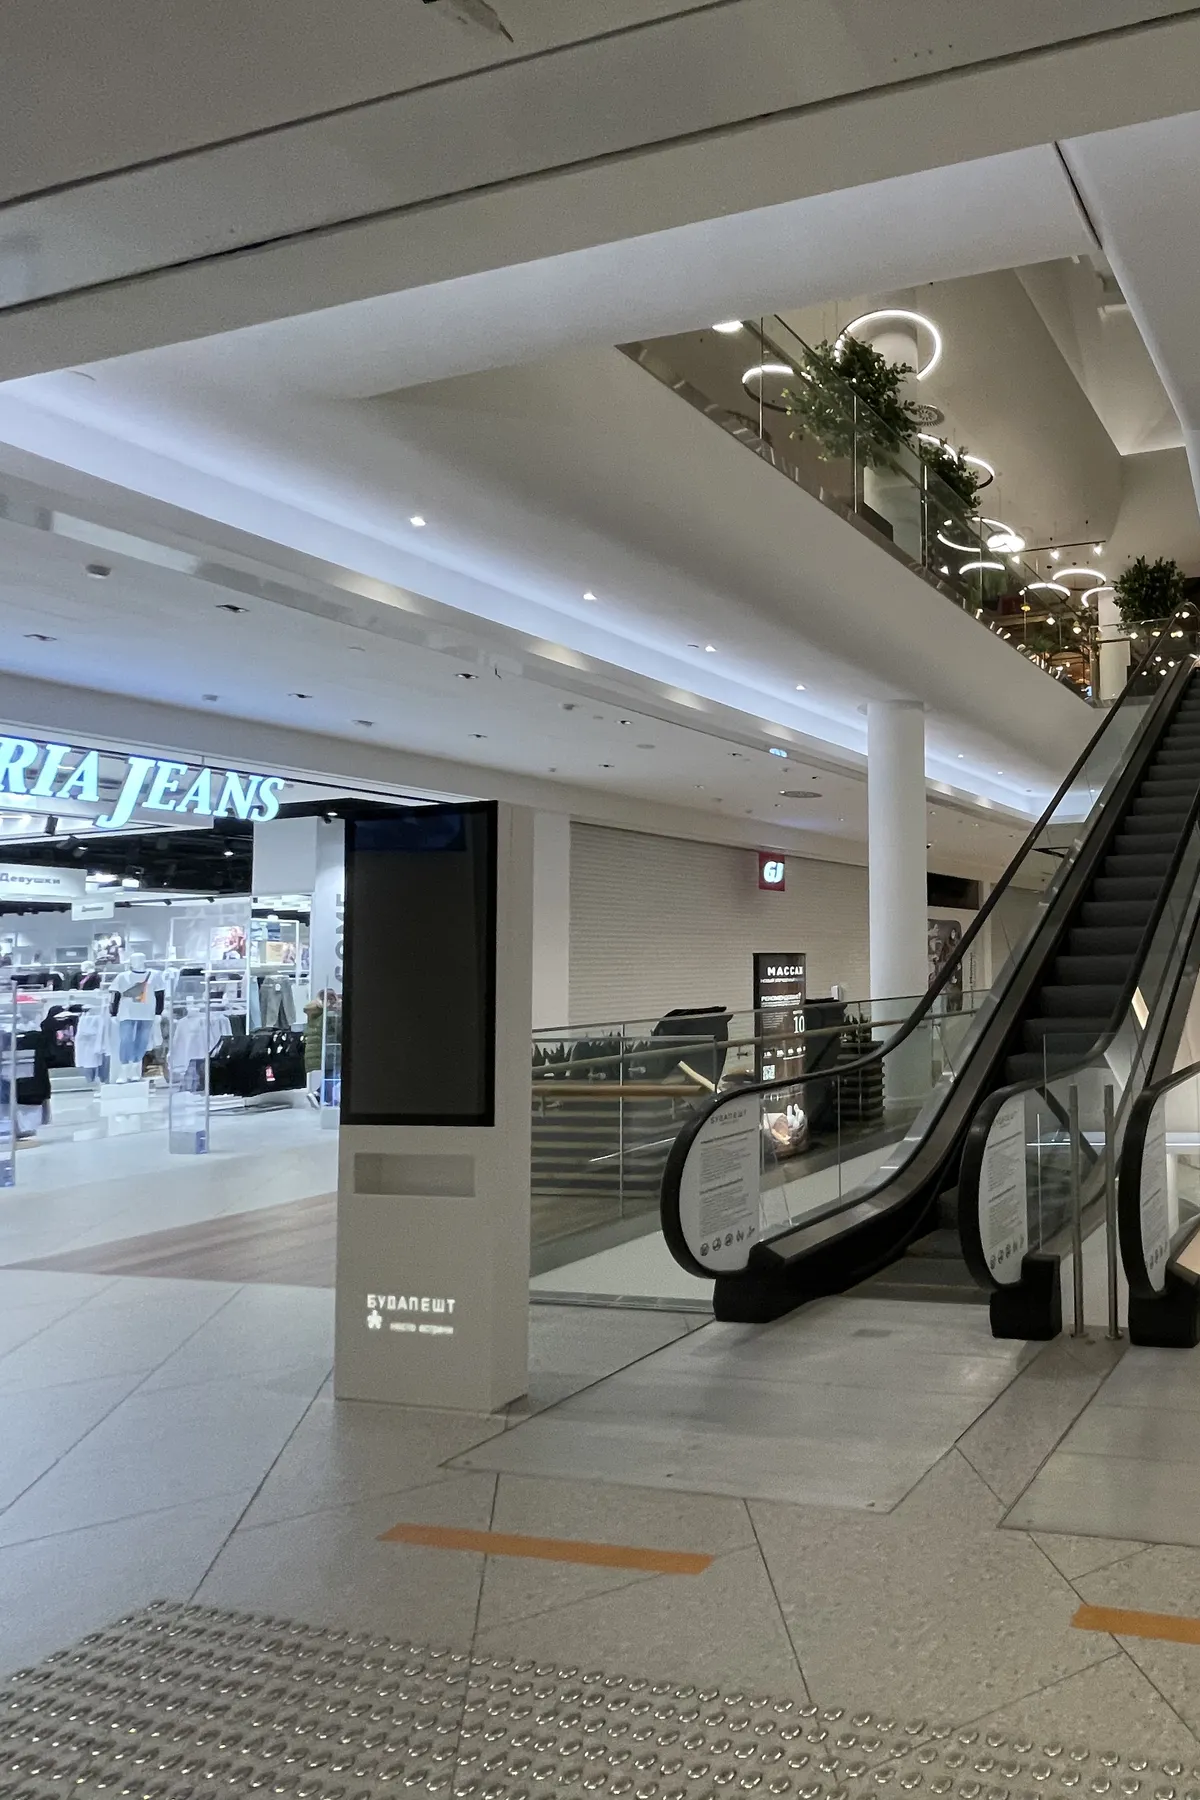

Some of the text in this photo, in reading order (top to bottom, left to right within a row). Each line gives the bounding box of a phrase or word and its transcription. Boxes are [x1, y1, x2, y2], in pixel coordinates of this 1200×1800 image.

[95, 757, 285, 828] JEANS
[0, 872, 61, 885] Девушки
[367, 1294, 456, 1314] БУДАПЕШТ
